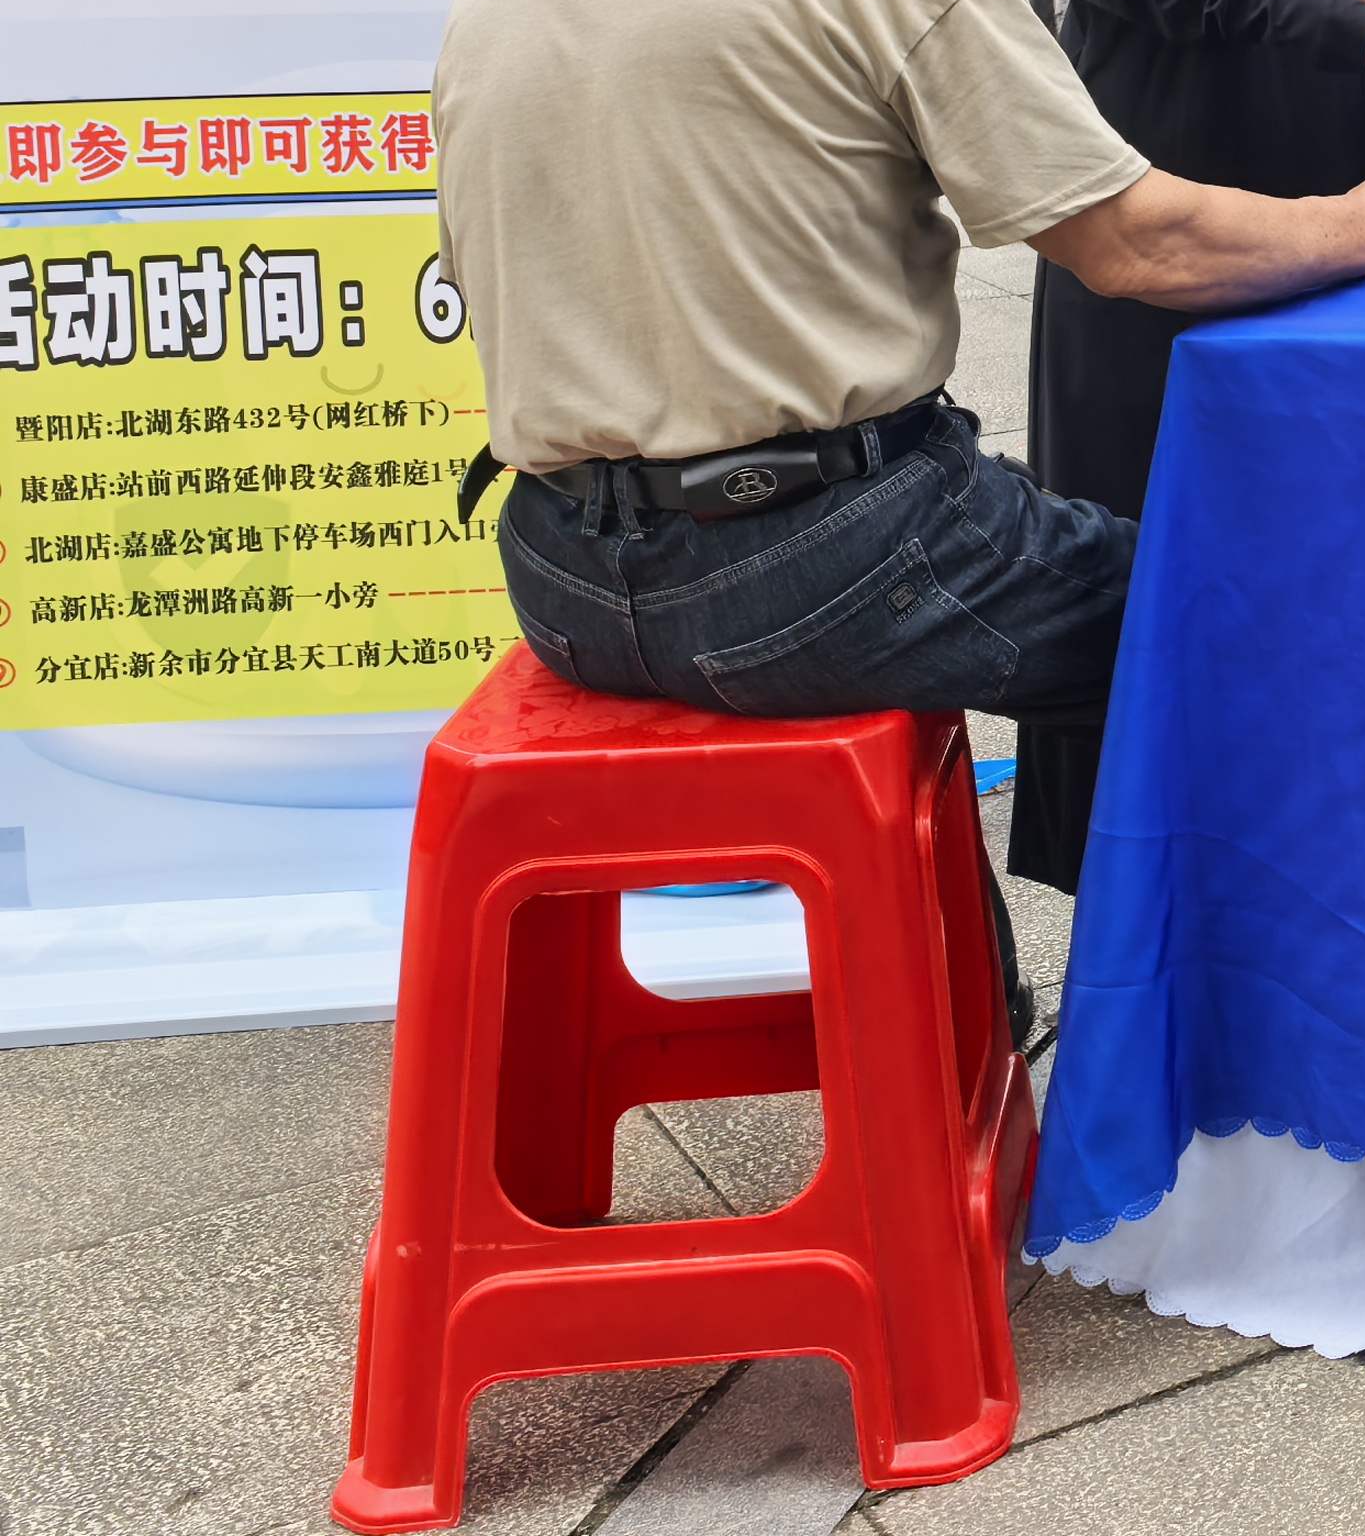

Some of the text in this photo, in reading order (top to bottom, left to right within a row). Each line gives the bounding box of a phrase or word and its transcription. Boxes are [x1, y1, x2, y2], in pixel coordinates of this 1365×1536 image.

[8, 113, 434, 183] 即参与即可获得
[20, 457, 498, 504] 康盛店:站前西路延伸段安鑫雅庭1号
[30, 581, 378, 624] 高新店:龙潭洲路高新一小旁
